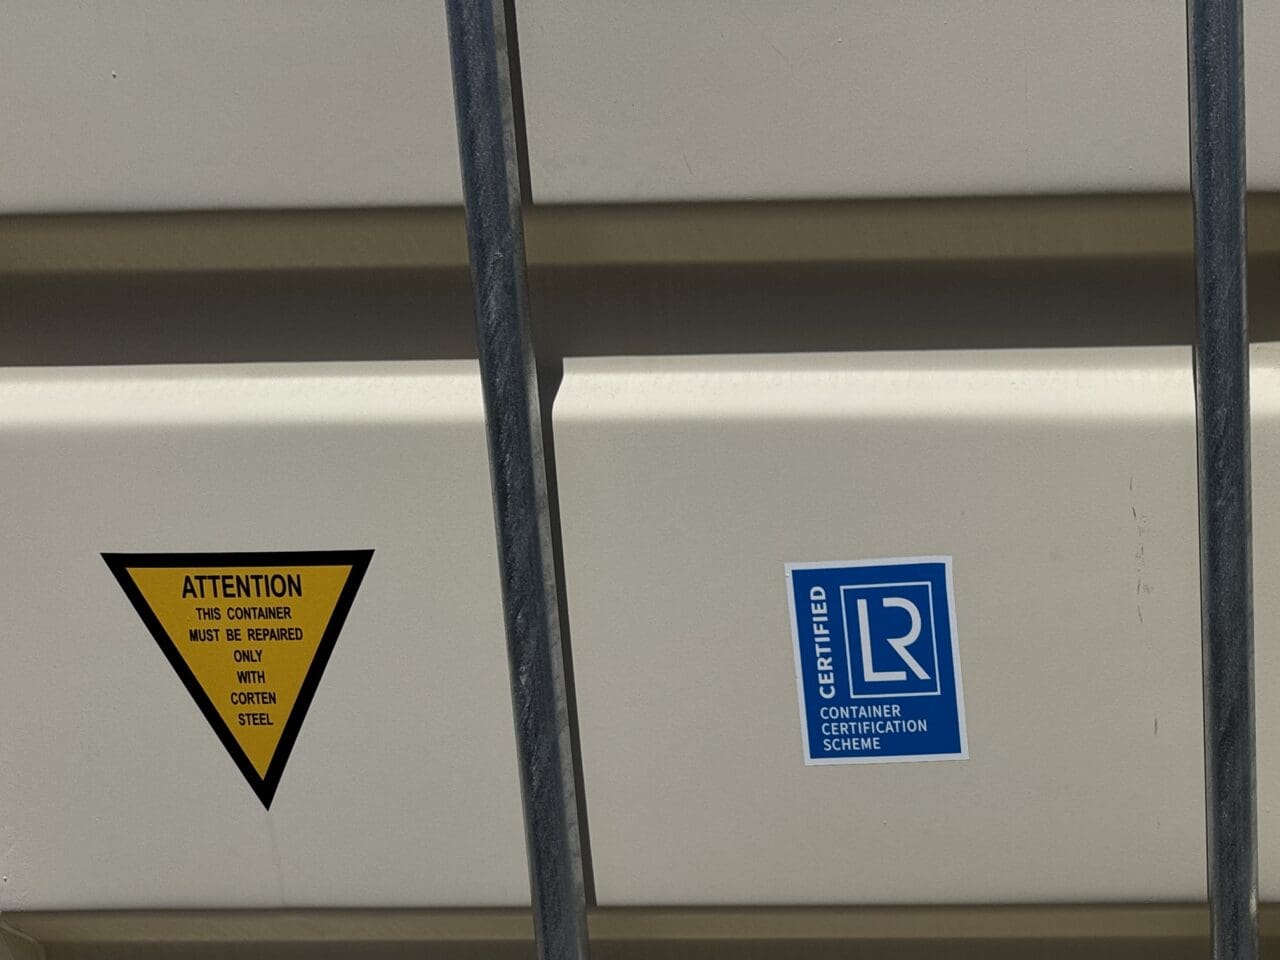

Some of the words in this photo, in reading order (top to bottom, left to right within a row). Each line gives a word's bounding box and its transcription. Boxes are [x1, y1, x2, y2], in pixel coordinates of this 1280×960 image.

[181, 573, 303, 599] ATTENTION
[195, 607, 222, 621] THIS
[226, 606, 292, 620] CONTAINER
[189, 628, 220, 642] MUST
[226, 628, 242, 641] BE
[247, 627, 303, 641] REPAIRED
[856, 596, 932, 683] LR
[809, 585, 836, 700] CERTIFIED
[233, 649, 263, 663] ONLY
[236, 670, 266, 684] WITH
[230, 691, 277, 705] CORTEN
[237, 712, 274, 726] STEEL
[820, 704, 901, 720] CONTAINER
[821, 719, 928, 736] CERTIFICATION
[823, 737, 881, 752] SCHEME
